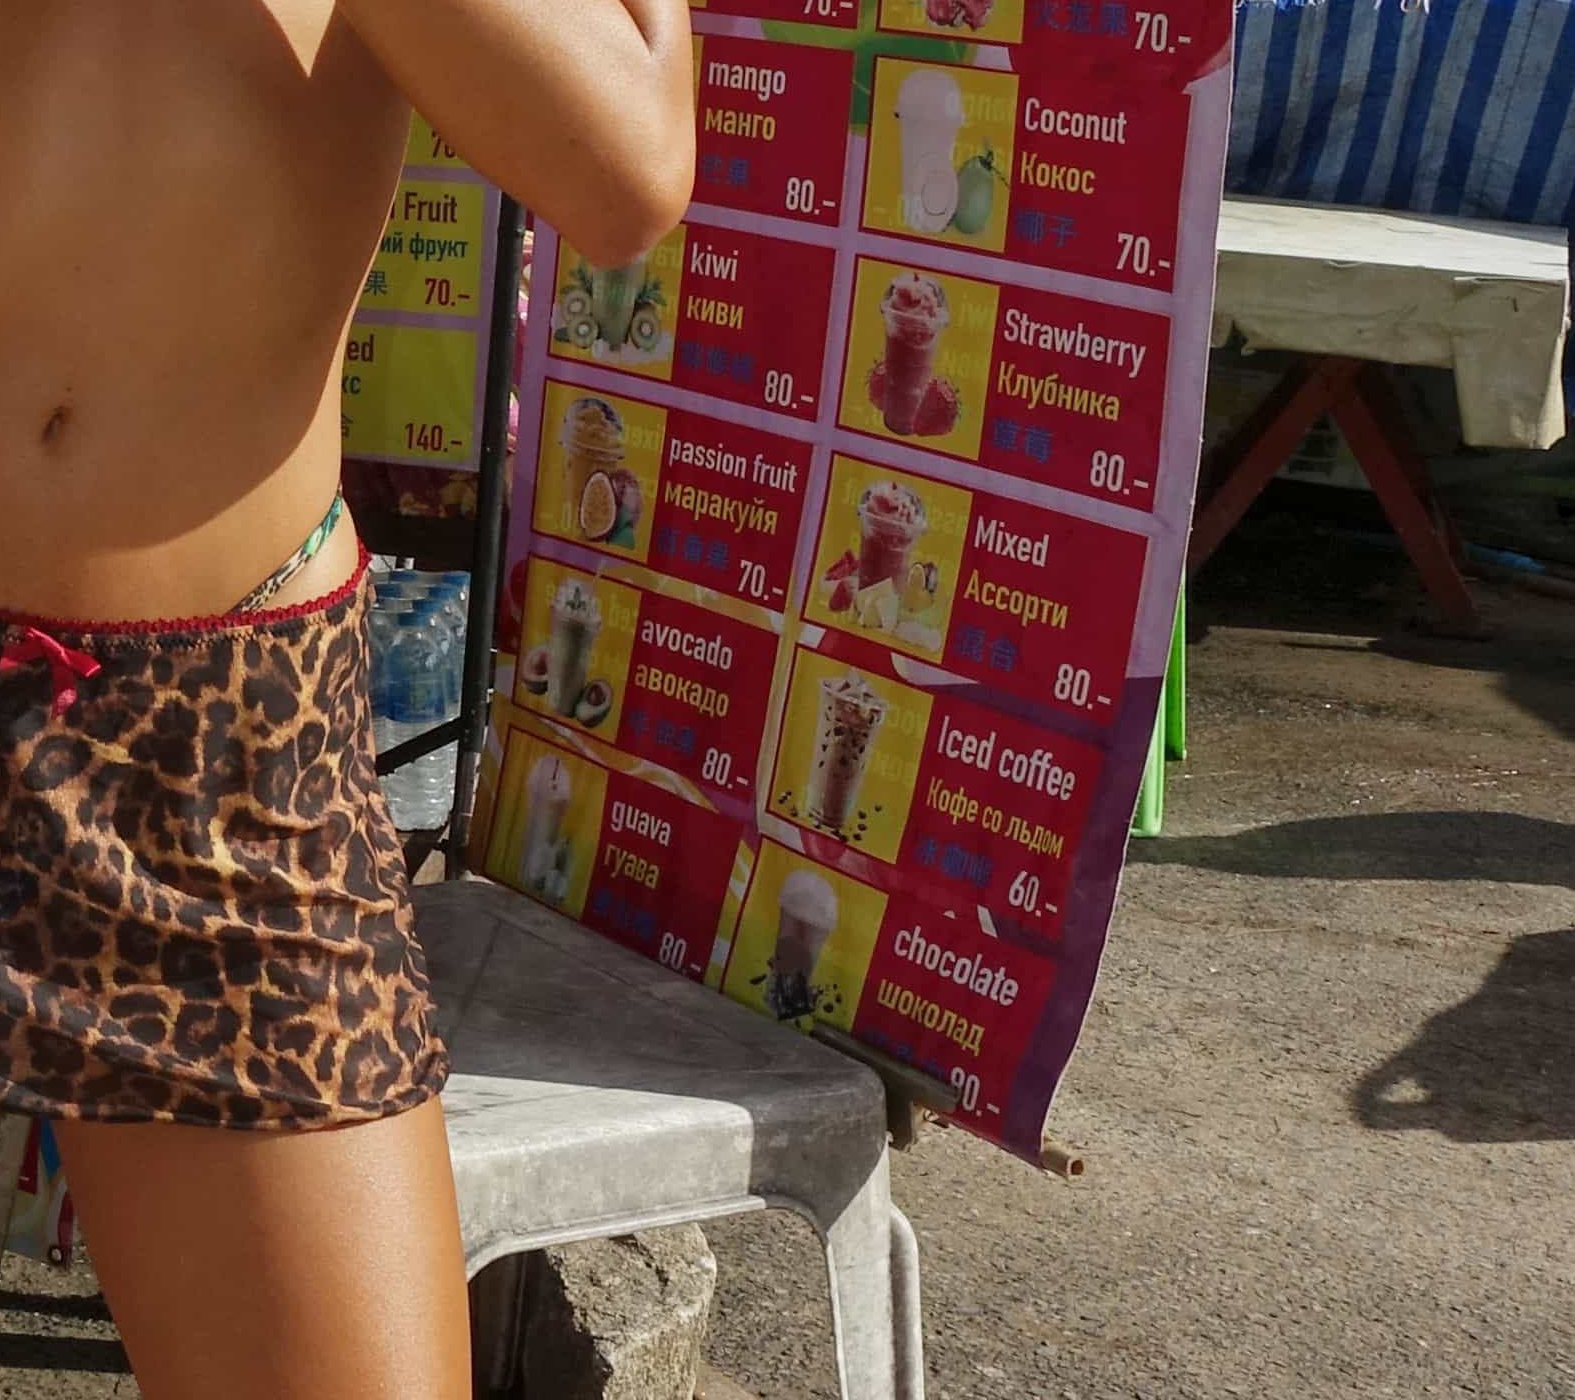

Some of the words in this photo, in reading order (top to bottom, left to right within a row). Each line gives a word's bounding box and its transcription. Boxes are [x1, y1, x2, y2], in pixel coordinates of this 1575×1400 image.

[1135, 12, 1191, 52] 70.-
[707, 58, 786, 101] mango
[705, 108, 776, 141] манго
[1025, 99, 1127, 146] Coconut
[1021, 151, 1095, 196] Кокос
[404, 192, 458, 224] Fruit
[786, 179, 836, 216] 80.-
[409, 234, 469, 260] фрукт
[690, 242, 737, 282] kiwi
[1116, 234, 1170, 278] 70.-
[425, 279, 470, 307] 70.-
[686, 296, 744, 330] киви
[1004, 309, 1146, 379] Strawberry
[765, 371, 814, 410] 80.-
[997, 364, 1120, 420] Клубника
[405, 423, 462, 452] 140.-
[669, 434, 746, 486] passion
[751, 454, 797, 492] fruit
[1090, 452, 1149, 498] 80.-
[664, 484, 779, 536] маракуйя
[974, 515, 1050, 569] Mixed
[739, 559, 784, 601] 70.-
[964, 570, 1069, 630] Ассорти
[641, 616, 734, 671] avocado
[634, 662, 730, 718] авокадо
[1054, 662, 1111, 711] 80.-
[701, 746, 749, 792] 80.-
[937, 715, 994, 766] Iced
[997, 748, 1076, 800] coffee
[611, 798, 673, 848] guava
[926, 778, 979, 822] Кофе
[981, 801, 1003, 832] со
[1004, 810, 1064, 860] льдом
[604, 841, 660, 890] гуава
[1007, 871, 1057, 918] 60.-
[657, 931, 701, 976] 80.-
[894, 924, 1019, 1008] chocolate
[876, 978, 985, 1056] шоколад
